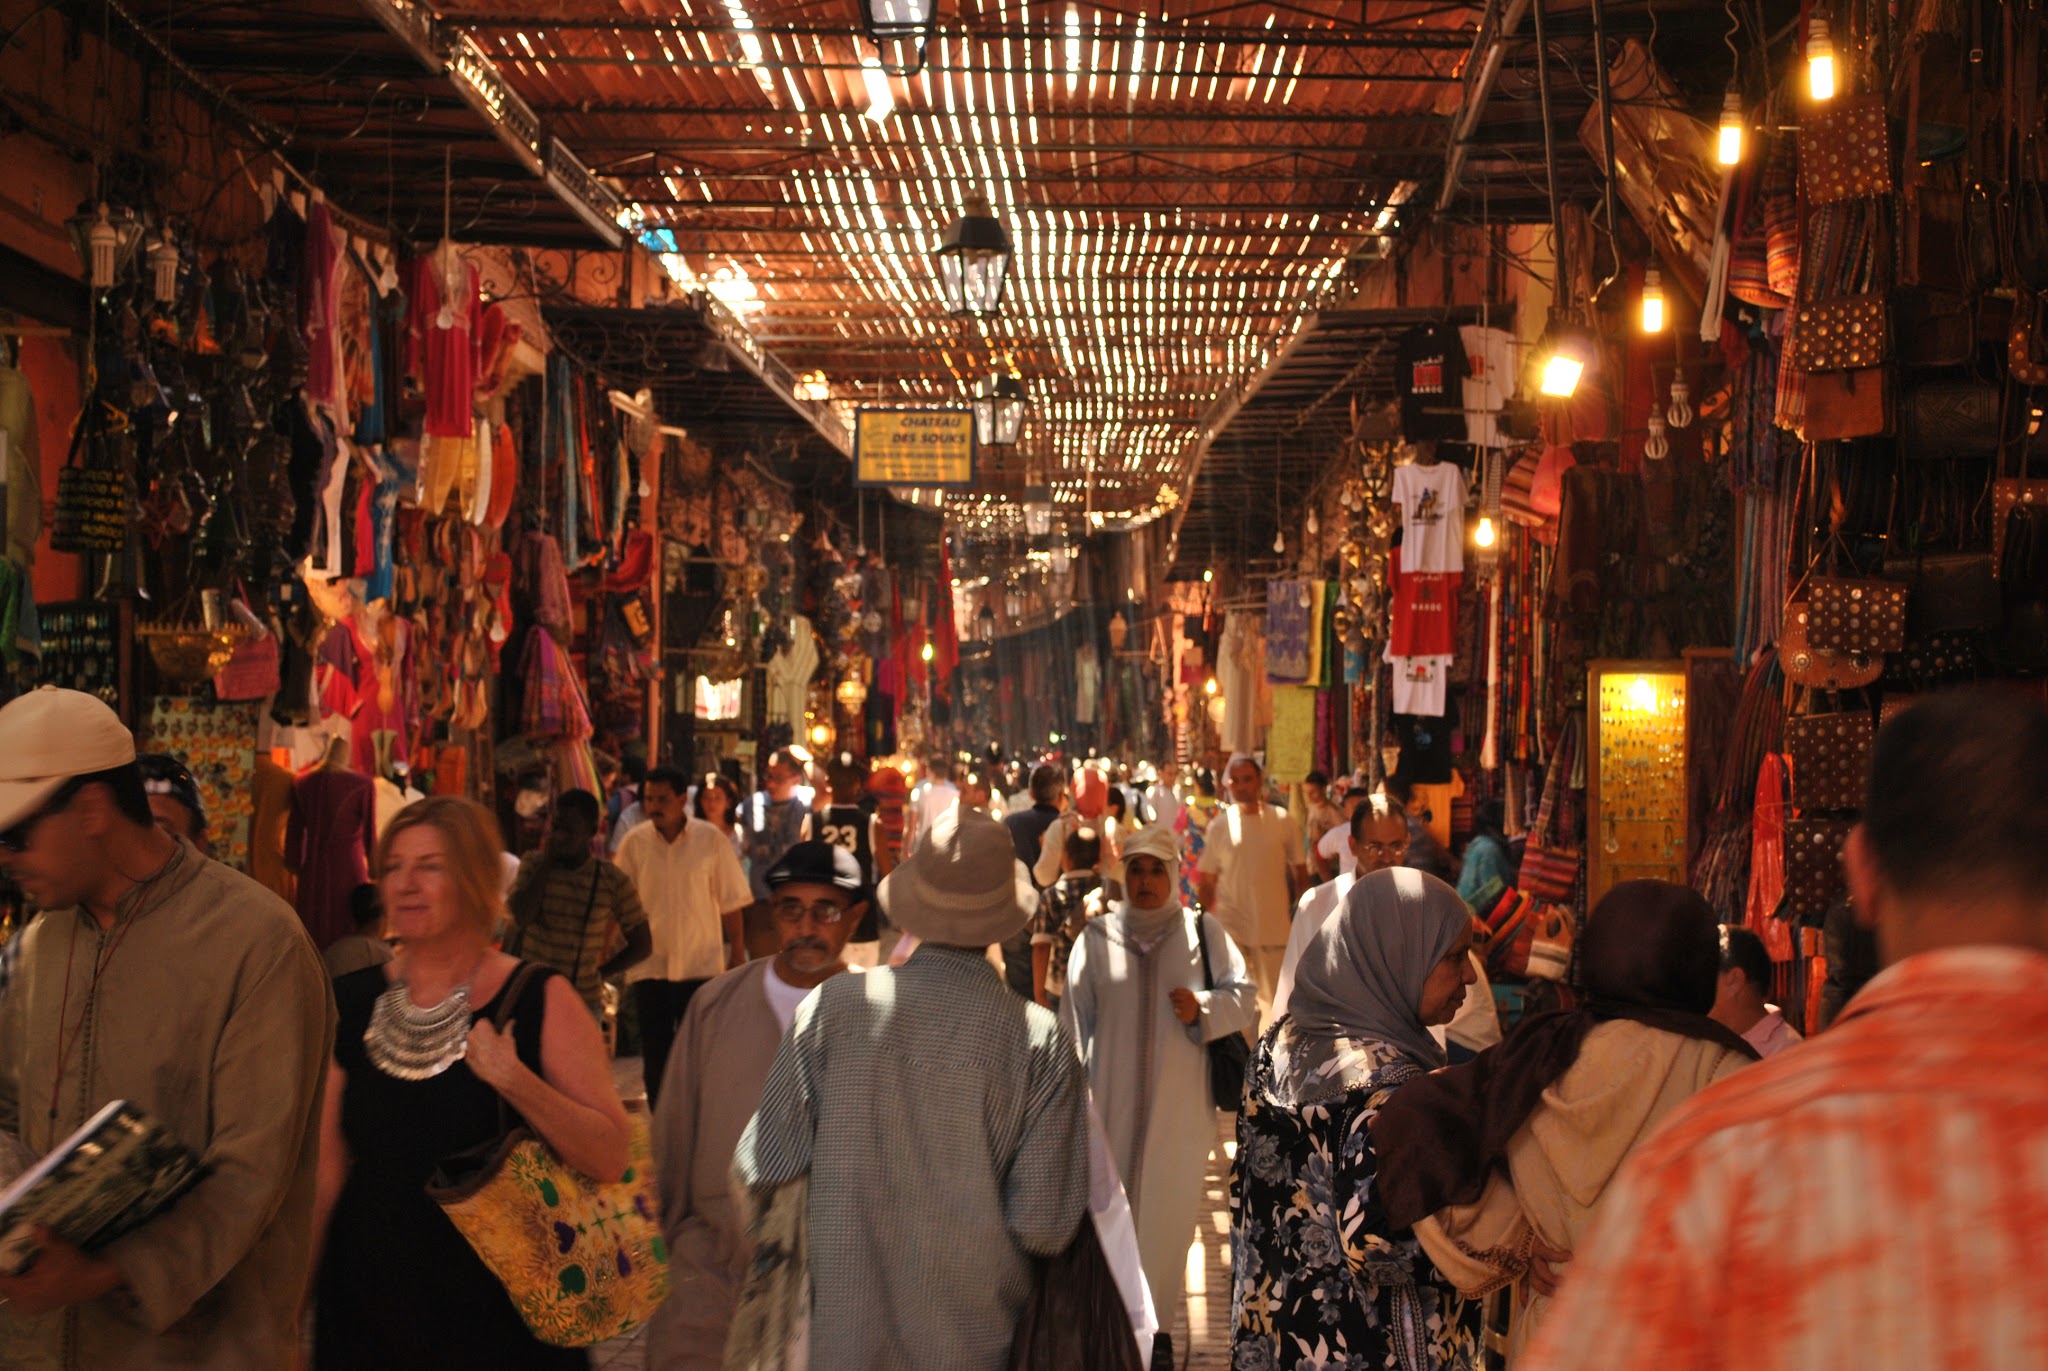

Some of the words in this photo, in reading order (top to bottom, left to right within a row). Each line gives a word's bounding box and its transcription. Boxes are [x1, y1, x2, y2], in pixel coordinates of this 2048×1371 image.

[1411, 386, 1443, 394] MAROC
[900, 417, 961, 427] CHATEAU
[892, 433, 916, 443] DES
[920, 433, 966, 443] SOUKS
[1411, 602, 1442, 612] MAROC
[821, 824, 859, 854] 23
